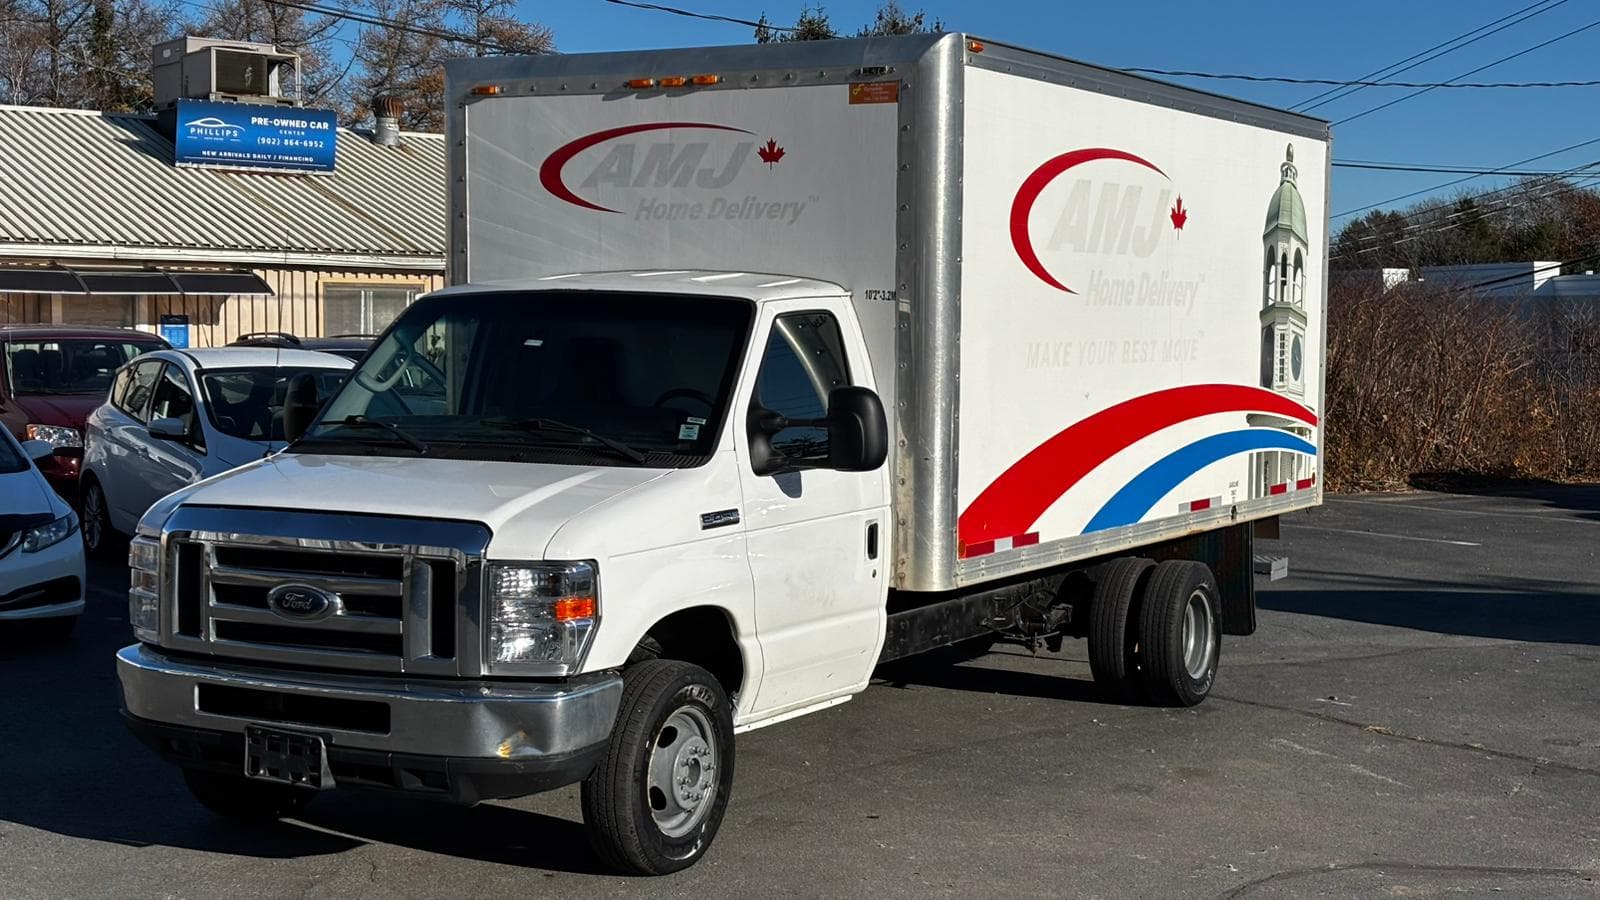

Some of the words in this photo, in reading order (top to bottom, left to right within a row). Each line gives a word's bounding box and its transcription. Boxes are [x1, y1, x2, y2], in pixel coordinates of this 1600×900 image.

[190, 127, 238, 137] PHILLIPS
[251, 116, 307, 128] PRE-OWNED
[309, 119, 329, 130] CAR
[257, 136, 281, 146] (902)
[283, 138, 324, 148] 864-6952
[218, 151, 250, 159] ARRIVALS
[278, 155, 314, 163] FINANCING
[579, 142, 754, 189] AMJ
[634, 196, 705, 221] Home
[707, 195, 808, 225] Delivery
[1046, 178, 1173, 258] AMJ
[1085, 269, 1136, 307] Home
[1136, 270, 1199, 316] Delivery
[1026, 341, 1072, 369] MAKE
[1079, 341, 1117, 366] YOUR
[1121, 339, 1157, 364] BEST
[1162, 338, 1199, 363] MOVE
[282, 592, 313, 610] Ford
